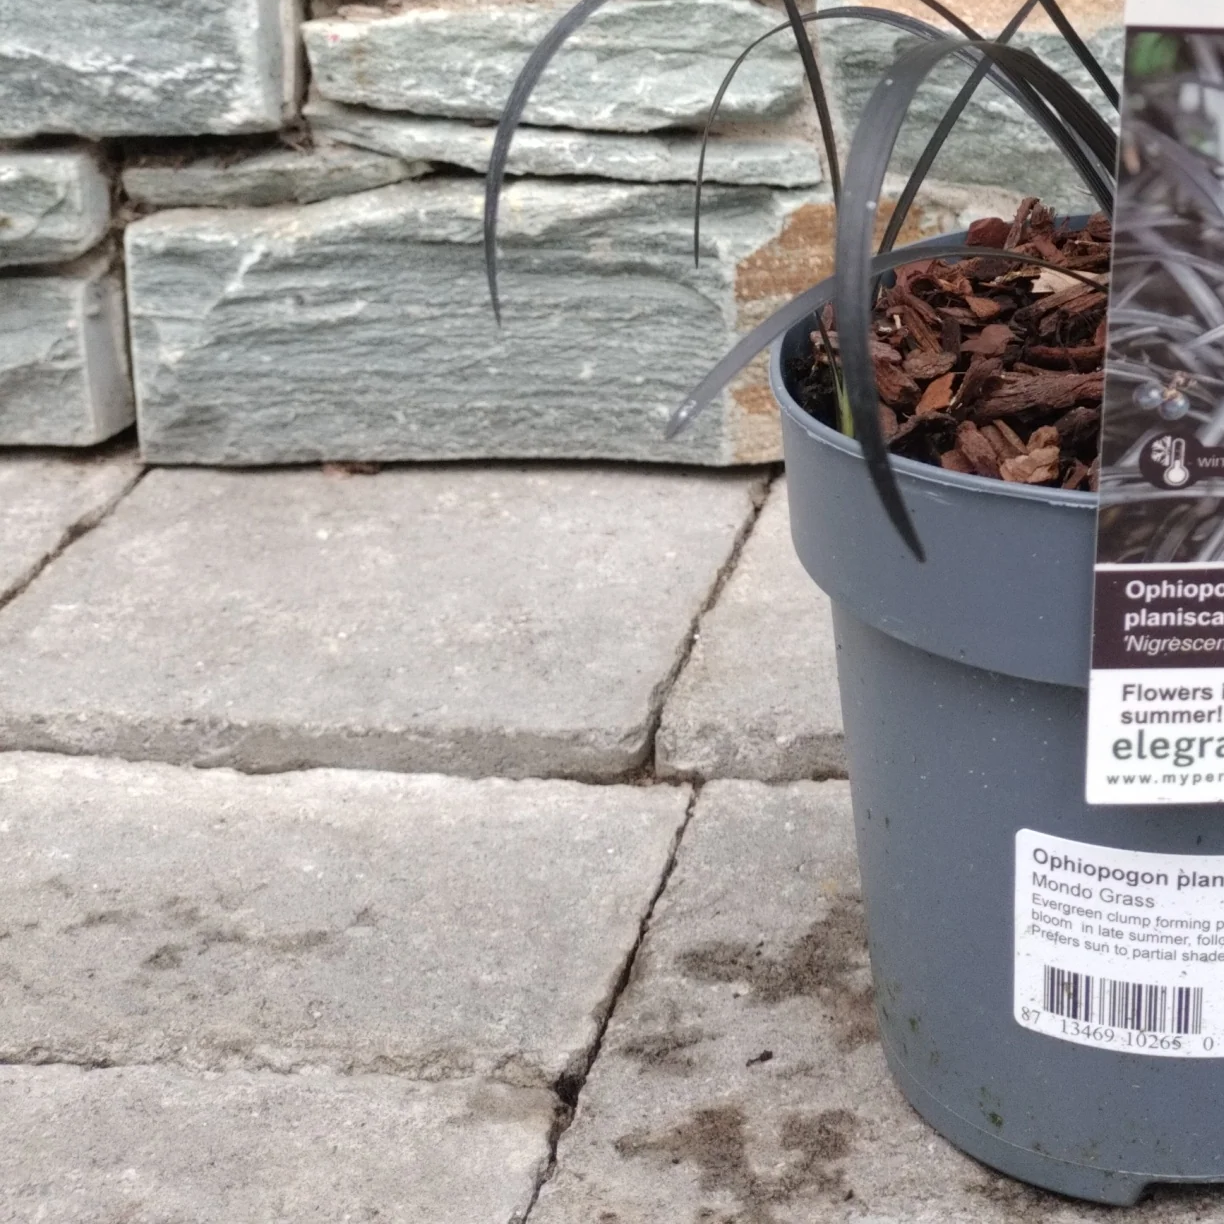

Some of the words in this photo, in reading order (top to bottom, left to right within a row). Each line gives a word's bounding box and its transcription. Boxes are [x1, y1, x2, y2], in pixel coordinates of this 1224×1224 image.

[1121, 683, 1214, 702] Flowers
[1120, 705, 1223, 725] summer!
[1032, 847, 1169, 887] Ophiopogon
[1032, 871, 1093, 900] Mondo
[1099, 887, 1155, 909] Grass
[1031, 907, 1073, 930] bloom
[1082, 921, 1094, 935] in
[1098, 924, 1124, 940] late
[1129, 930, 1192, 947] summer,
[1032, 892, 1102, 920] Evergreen
[1107, 911, 1151, 929] clump
[1156, 915, 1211, 933] forming
[1031, 923, 1080, 948] Prefers
[1084, 939, 1110, 954] sun
[1114, 944, 1128, 956] to
[1132, 947, 1177, 961] partial
[1021, 1005, 1041, 1025] 87
[1060, 1018, 1115, 1043] 13469
[1126, 1030, 1182, 1051] 10265
[1203, 1036, 1215, 1051] 0
